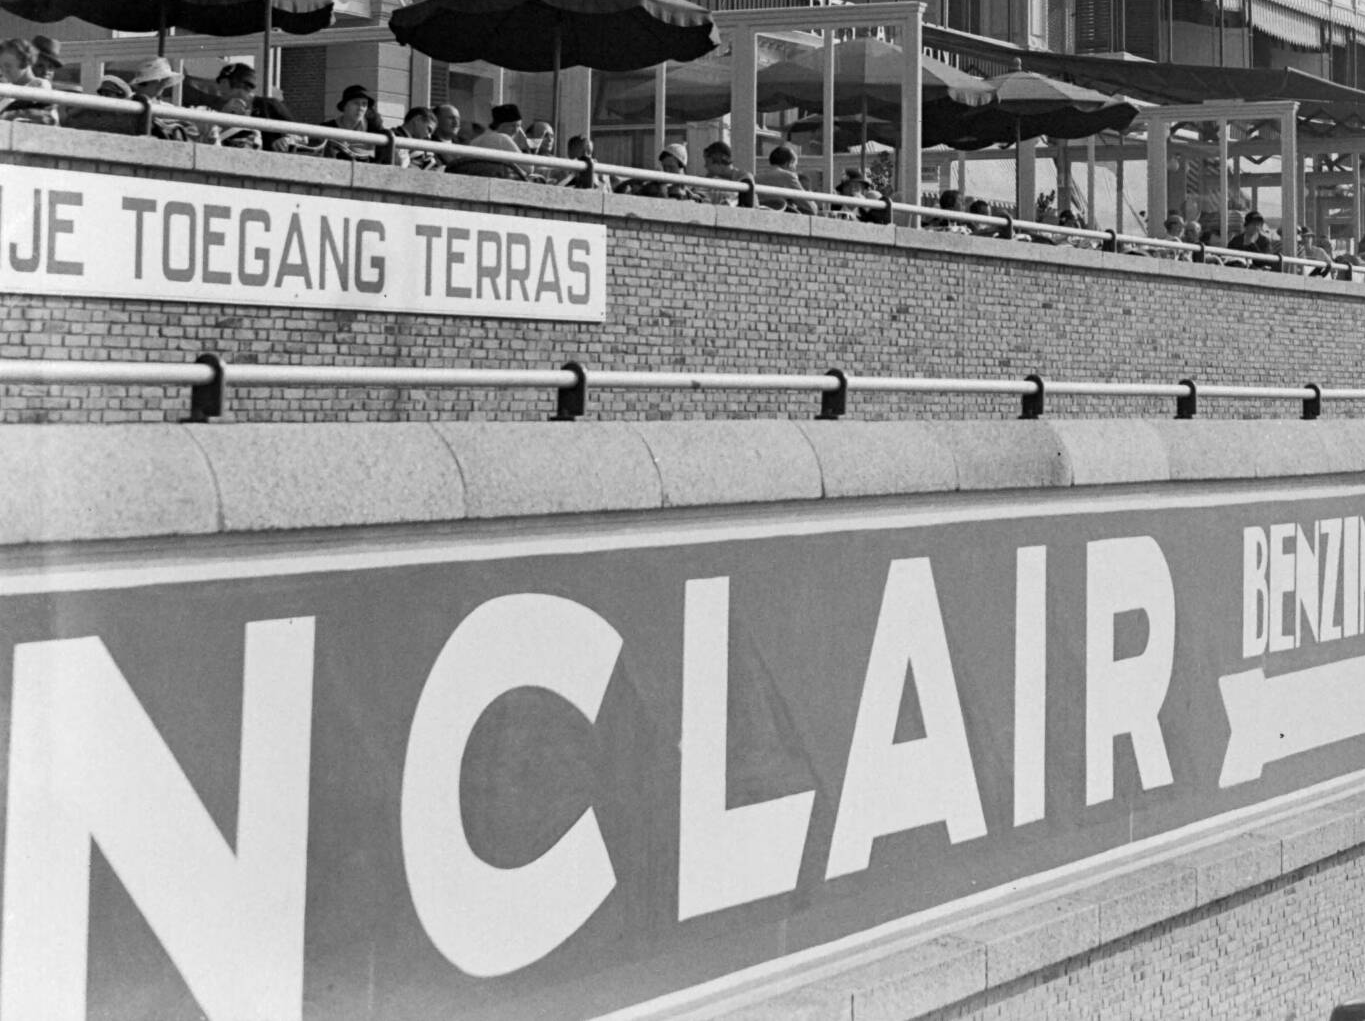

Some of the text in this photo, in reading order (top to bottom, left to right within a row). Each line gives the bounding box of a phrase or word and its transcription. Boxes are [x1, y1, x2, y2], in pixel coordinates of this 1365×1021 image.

[0, 185, 591, 305] JE TOEGANG TERRAS
